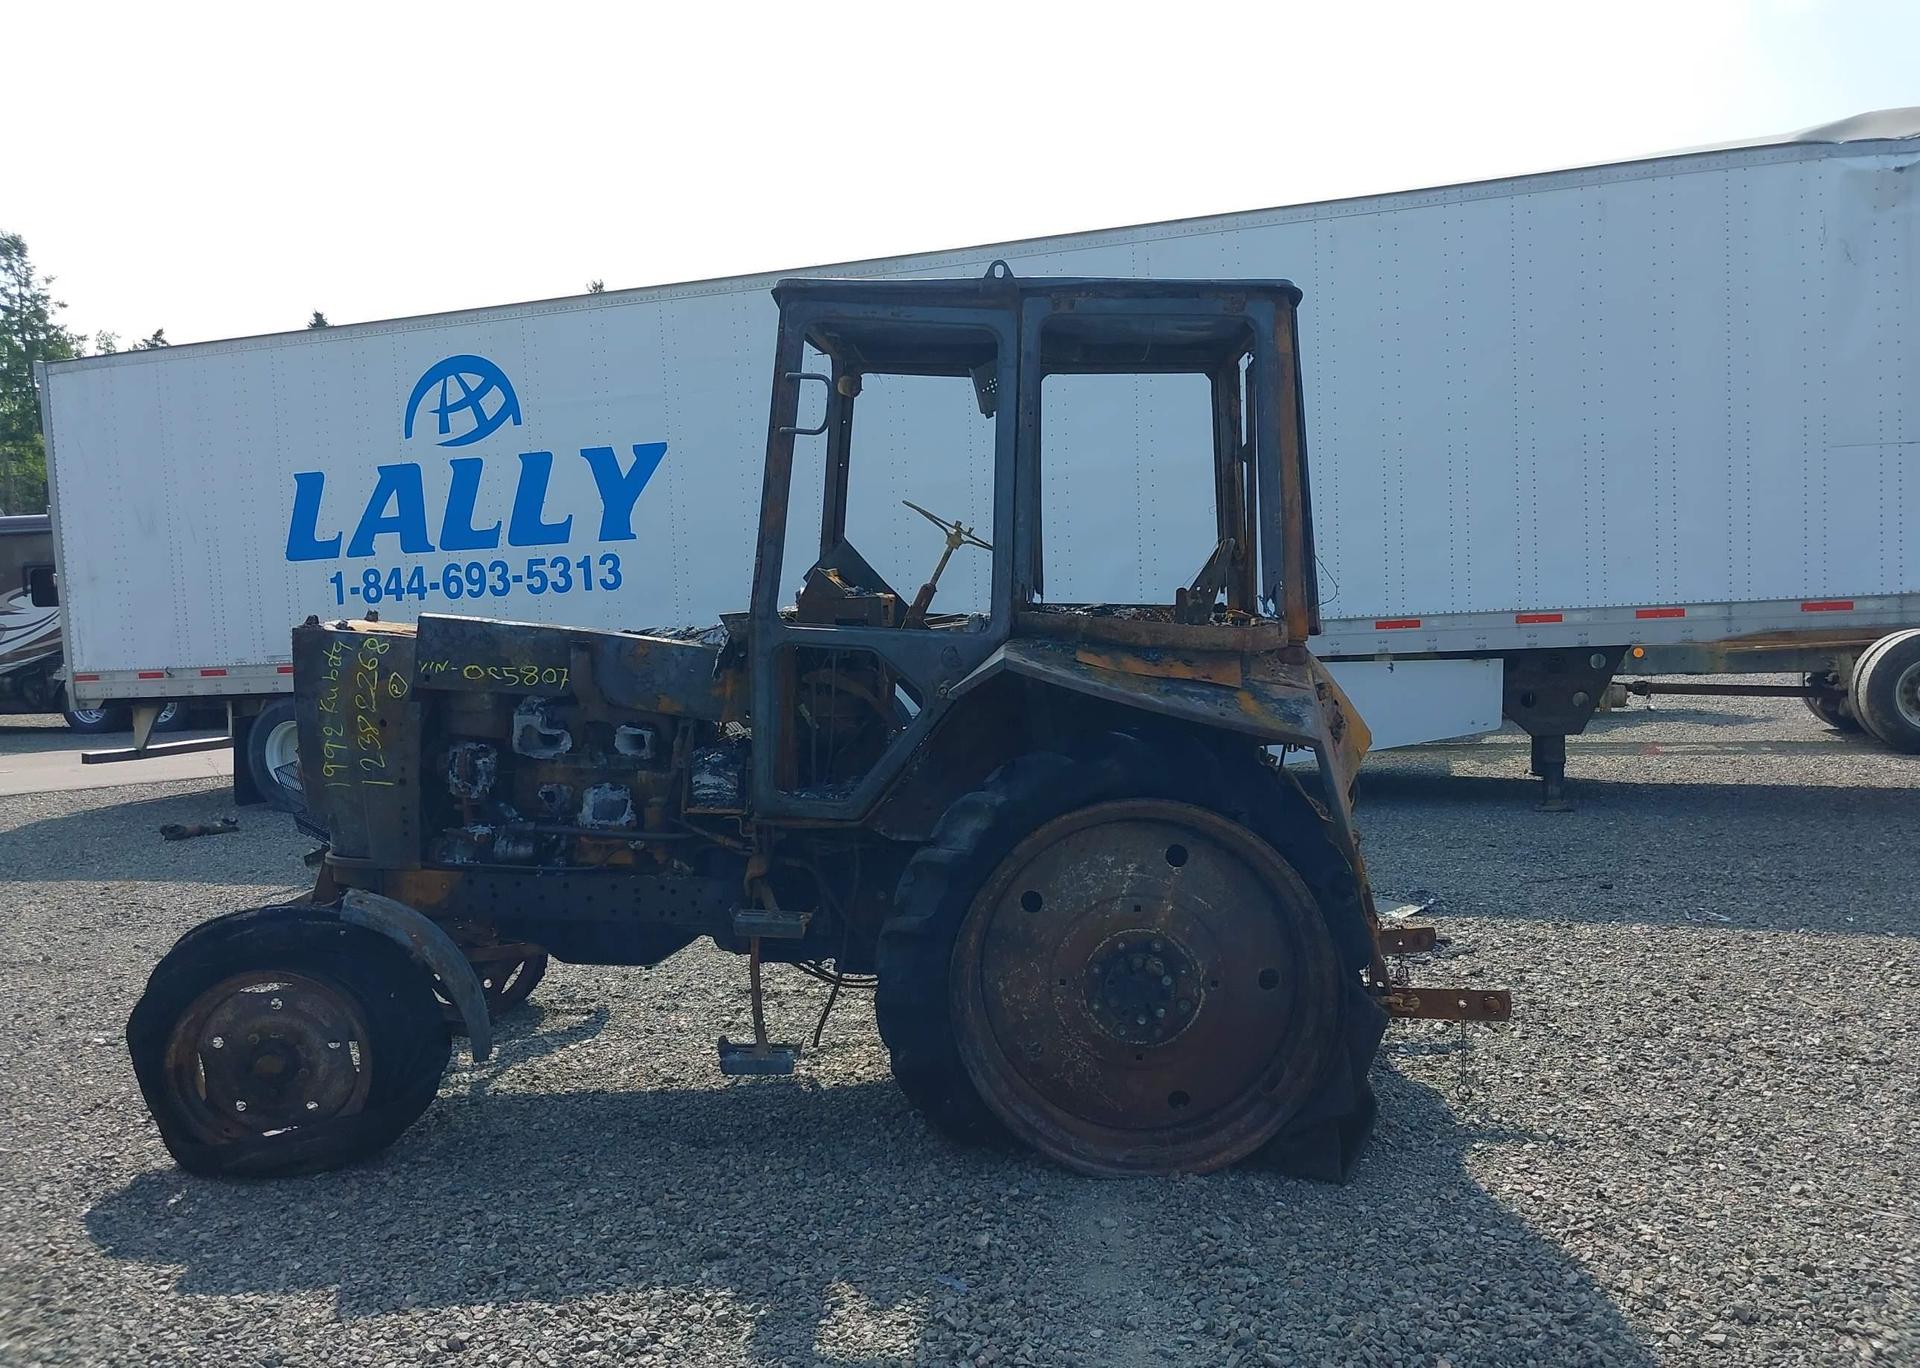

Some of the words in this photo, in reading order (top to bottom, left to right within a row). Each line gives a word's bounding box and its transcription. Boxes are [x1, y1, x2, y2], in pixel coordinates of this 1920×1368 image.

[286, 442, 667, 562] LALLY
[329, 553, 622, 606] 1-844-693-5313
[323, 720, 351, 787] 1992
